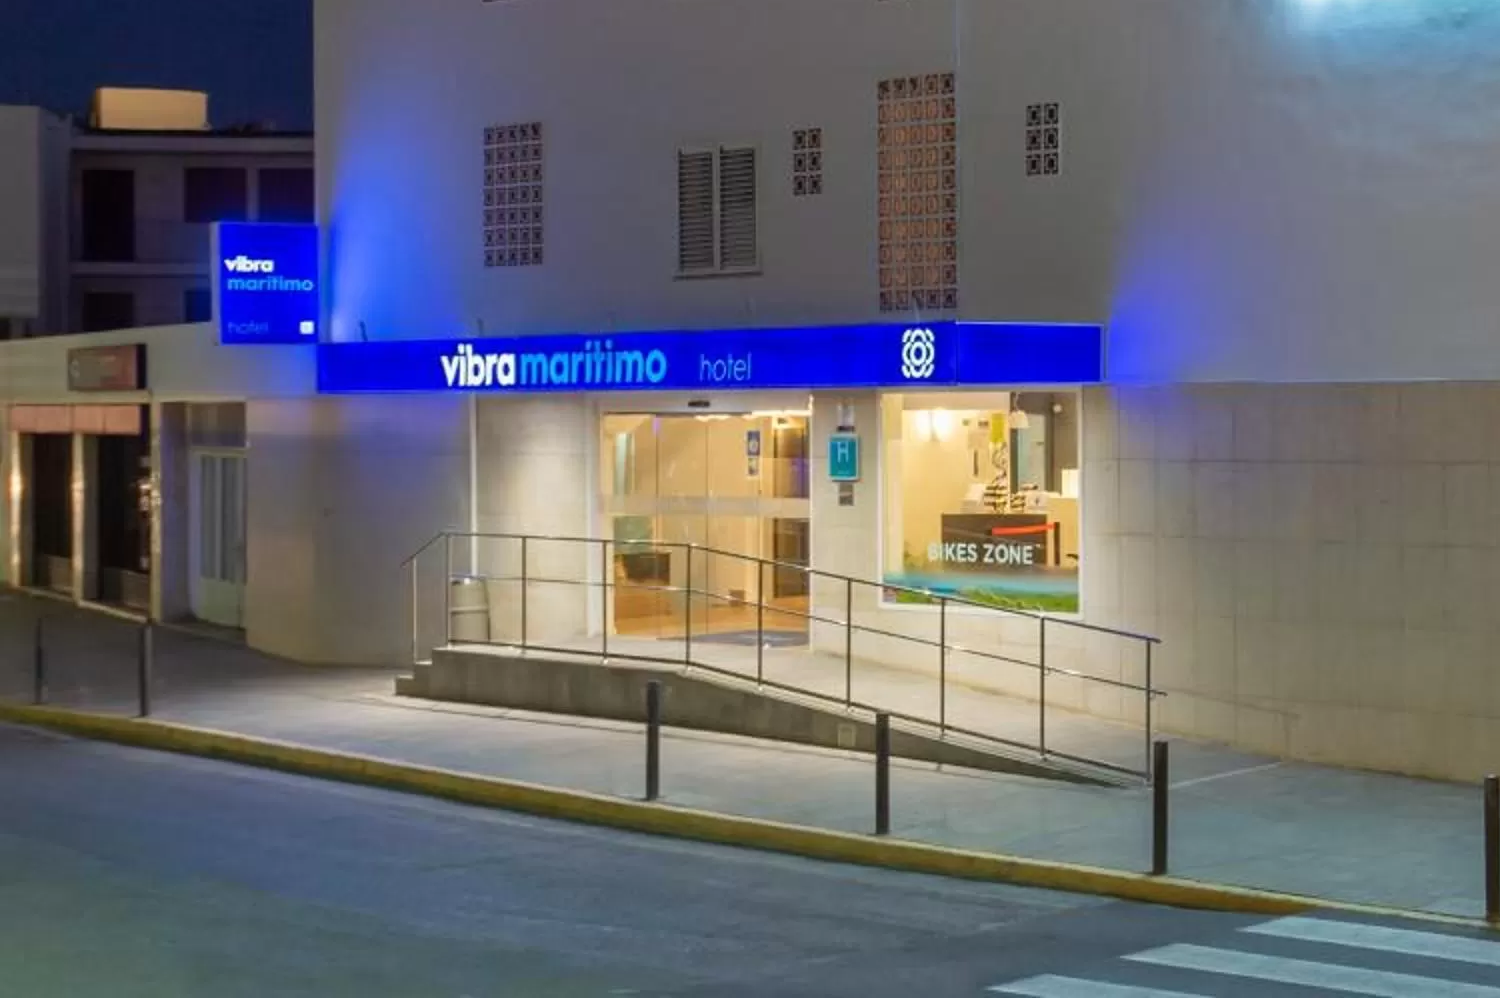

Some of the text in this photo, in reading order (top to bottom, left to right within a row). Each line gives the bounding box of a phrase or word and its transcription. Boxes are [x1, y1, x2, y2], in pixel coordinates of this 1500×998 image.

[224, 255, 275, 272] vibra
[700, 352, 752, 381] hotel
[837, 441, 849, 463] H
[927, 541, 978, 563] BIKES
